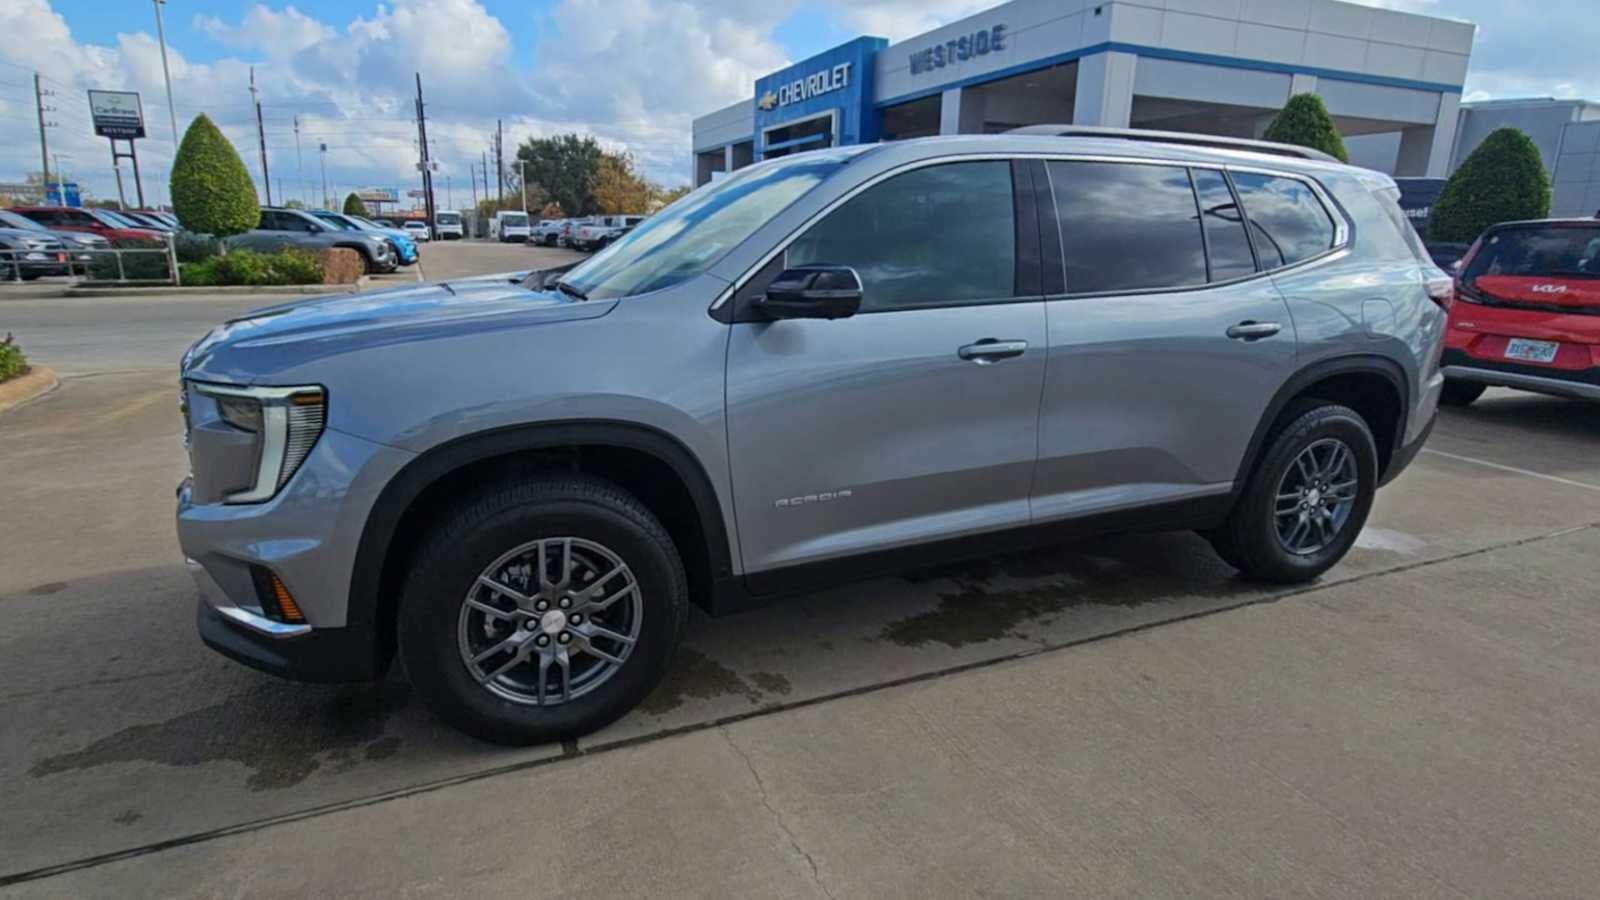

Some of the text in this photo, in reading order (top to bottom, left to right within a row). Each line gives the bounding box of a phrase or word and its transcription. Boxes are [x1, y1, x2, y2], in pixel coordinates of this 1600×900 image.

[909, 24, 1007, 75] WESTSIDE
[779, 61, 852, 106] CHEVROLET
[775, 490, 852, 507] ACADIA
